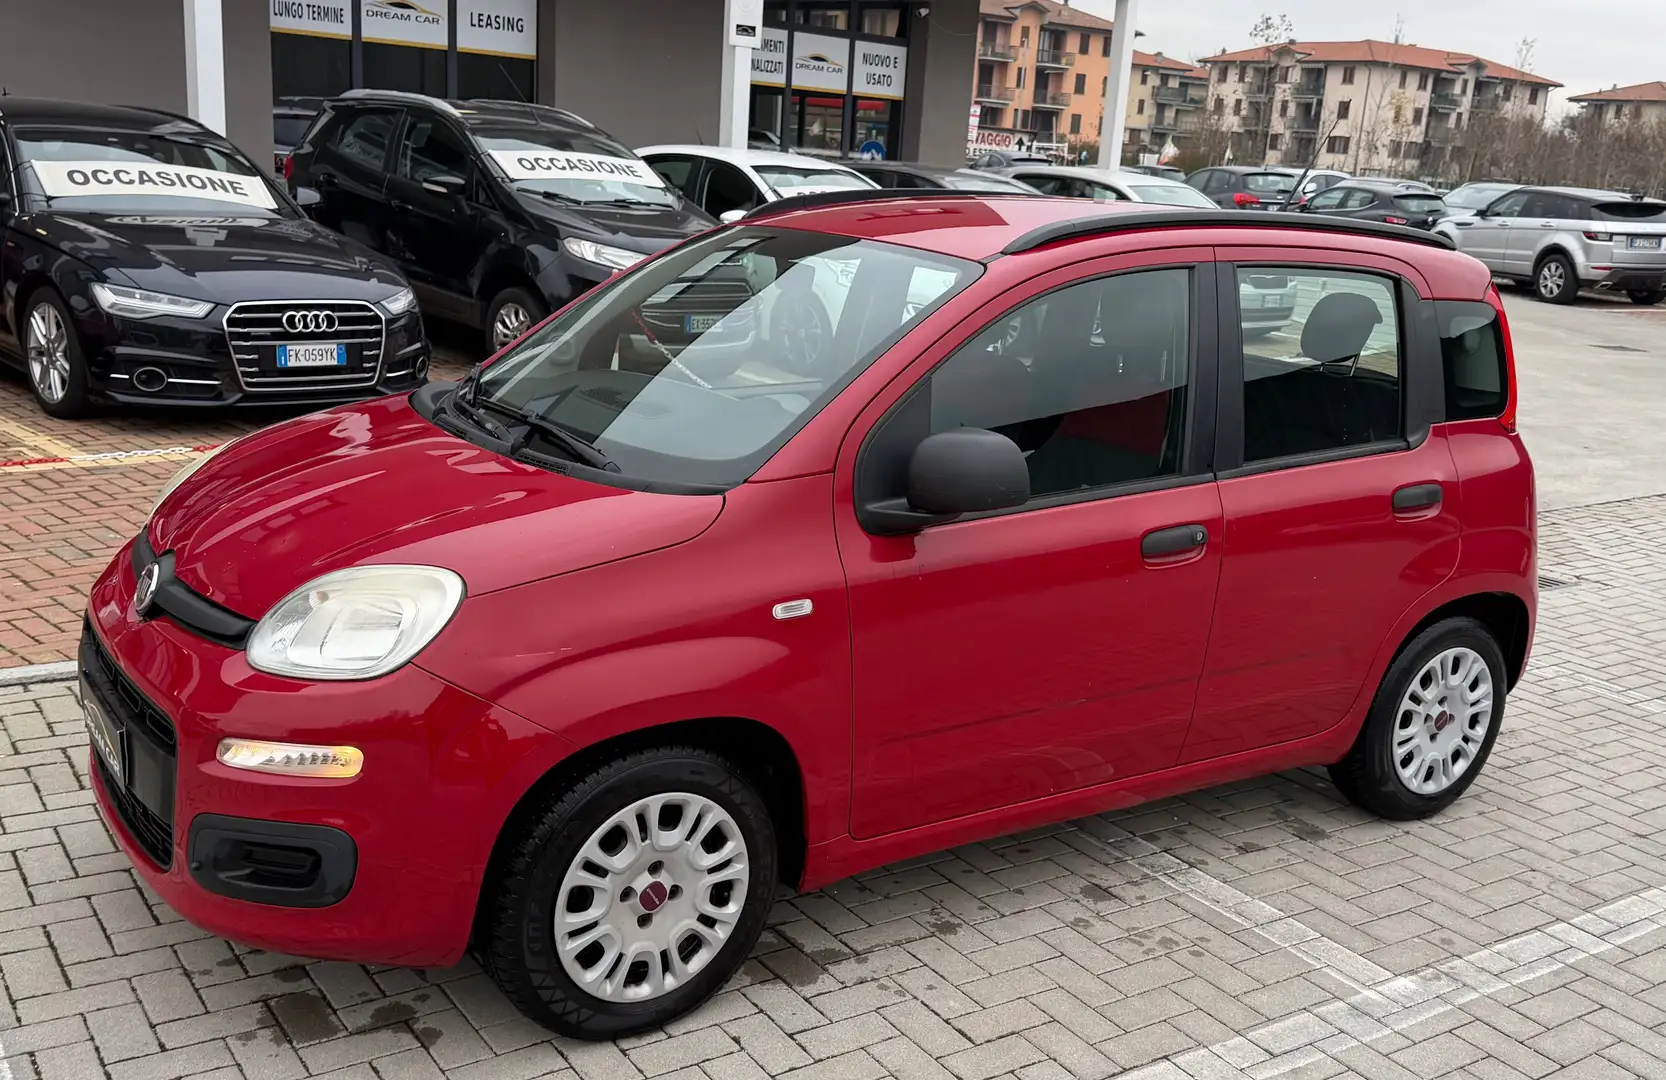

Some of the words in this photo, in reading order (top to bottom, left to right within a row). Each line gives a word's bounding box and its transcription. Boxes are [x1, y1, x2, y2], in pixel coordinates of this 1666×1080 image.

[273, 0, 303, 19] LUNGO
[306, 4, 344, 24] TERMINE
[366, 9, 411, 22] DREAM
[415, 14, 440, 25] CAR
[470, 12, 524, 33] LEASING
[795, 62, 824, 73] DREAM
[827, 66, 843, 74] CAR
[862, 52, 890, 68] NUOVO
[893, 57, 898, 68] E
[866, 69, 892, 87] USATO
[517, 157, 642, 178] OCCASIONE
[66, 169, 249, 197] OCCASIONE
